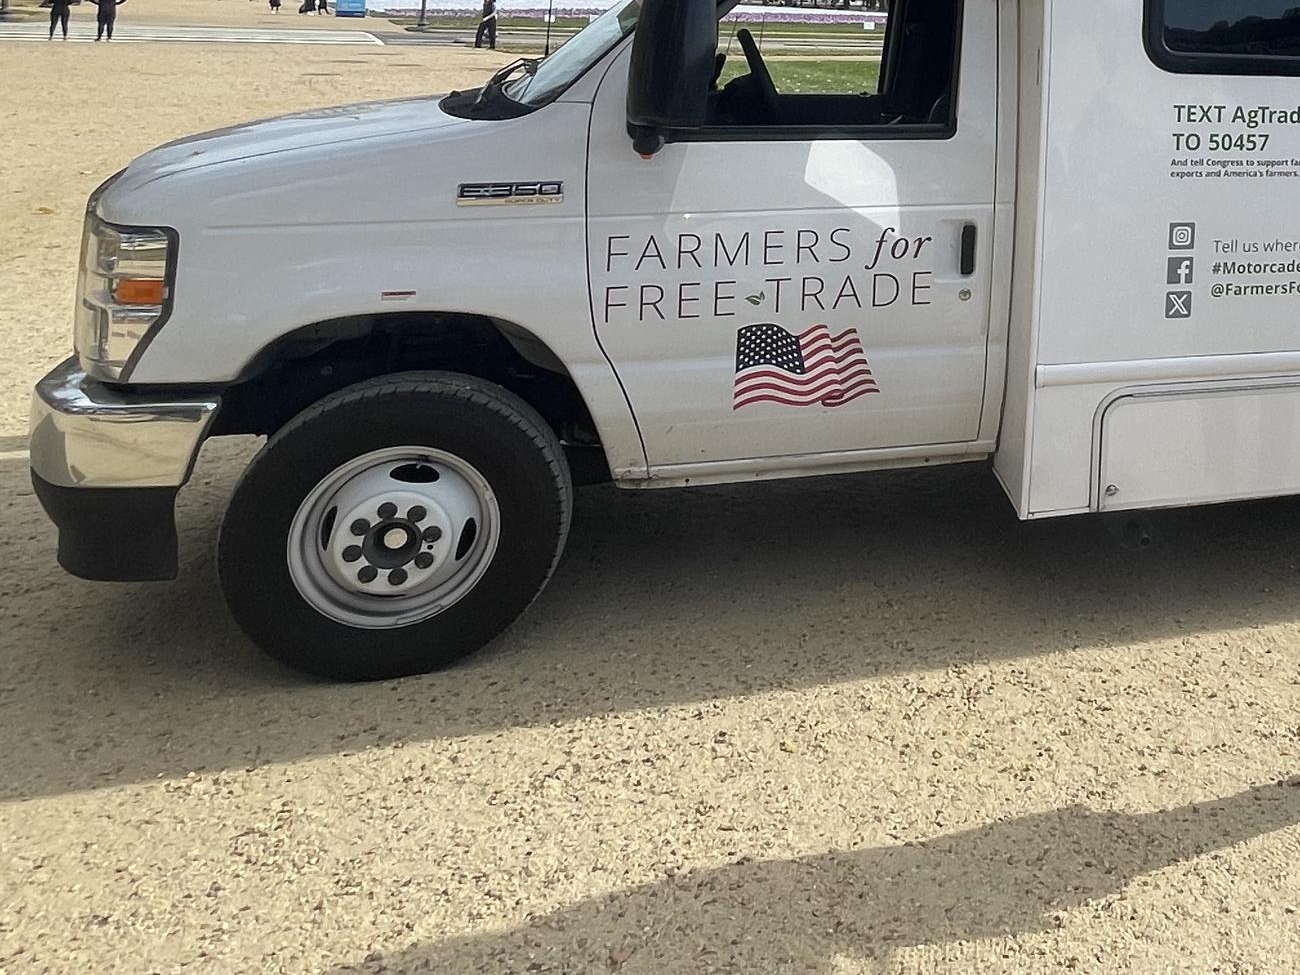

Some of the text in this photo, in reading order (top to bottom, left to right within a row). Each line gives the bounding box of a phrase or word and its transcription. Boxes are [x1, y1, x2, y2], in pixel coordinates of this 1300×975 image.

[1173, 105, 1226, 123] TEXT
[1172, 133, 1270, 152] TO 50457
[1170, 158, 1188, 167] And
[1190, 158, 1204, 167] tell
[1206, 158, 1244, 169] Congress
[1246, 159, 1255, 167] to
[1256, 159, 1289, 168] support
[1170, 169, 1300, 180] exports and America's farmers.
[605, 228, 933, 273] FARMERS for
[1213, 239, 1239, 254] Tell
[1243, 241, 1260, 254] us
[603, 271, 934, 324] FREE TRADE
